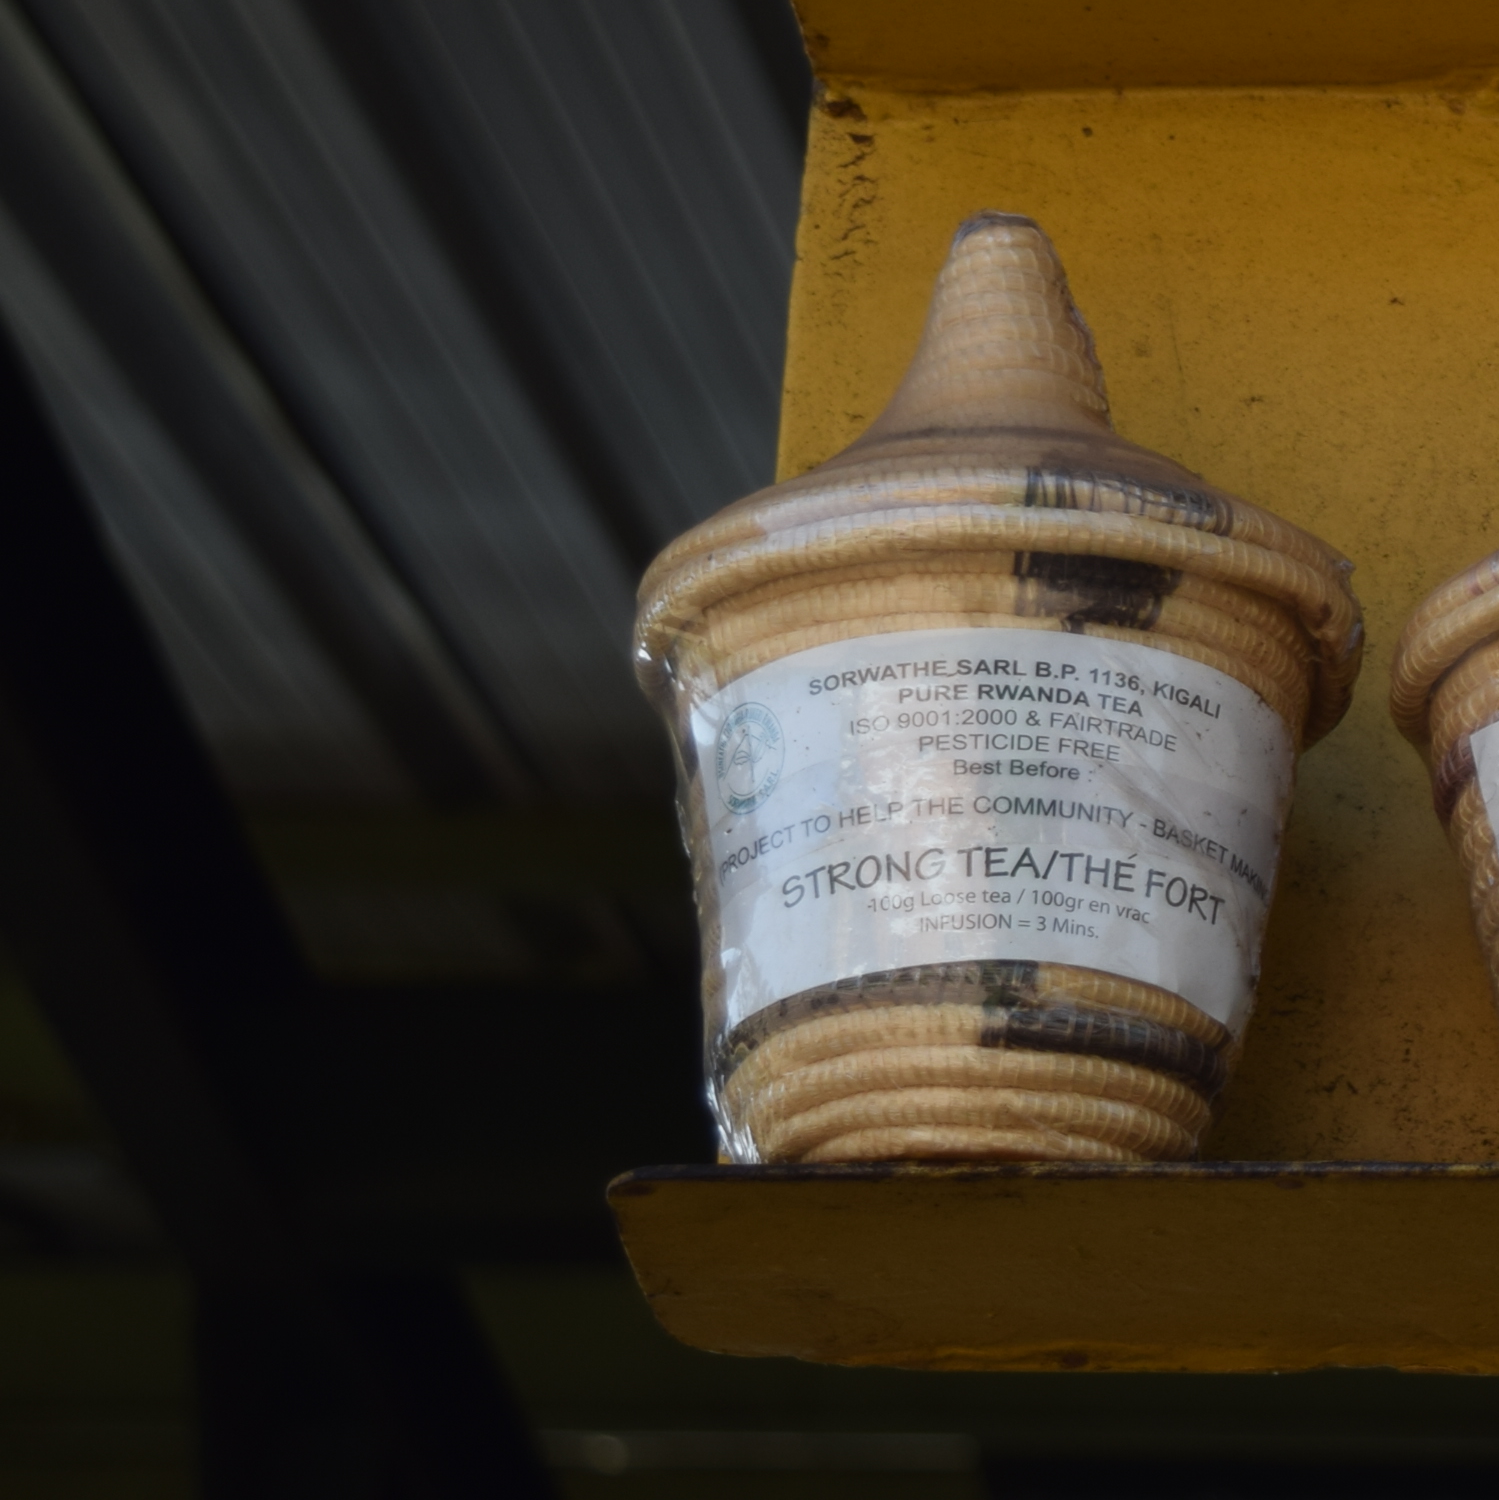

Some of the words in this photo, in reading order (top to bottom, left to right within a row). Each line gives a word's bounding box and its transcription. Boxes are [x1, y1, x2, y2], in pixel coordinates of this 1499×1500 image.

[808, 660, 947, 696] SORWATHE
[956, 659, 1027, 677] SARL
[1034, 661, 1079, 682] B.P.
[1089, 668, 1145, 696] 1136,
[1153, 680, 1222, 719] KIGALI
[899, 684, 969, 704] PURE
[977, 684, 1090, 708] RWANDA
[1099, 693, 1144, 718] TEA
[850, 715, 890, 736] ISO
[897, 708, 1018, 729] 9001:2000
[1026, 709, 1042, 727] &
[1049, 711, 1178, 752] FAIRTRADE
[918, 733, 1050, 753] PESTICIDE
[1058, 738, 1121, 763] FREE
[953, 759, 1003, 777] Best
[1010, 759, 1080, 780] Before
[801, 815, 831, 838] TO
[838, 800, 903, 829] HELP
[912, 797, 965, 816] THE
[973, 796, 1134, 828] COMMUNITY
[1153, 818, 1229, 865] BASKET
[782, 847, 946, 908] STRONG
[957, 846, 1138, 892] TEA/THÉ
[1145, 868, 1226, 926] FORT
[921, 889, 976, 906] Loose
[982, 889, 1012, 904] tea
[1032, 889, 1085, 913] 100gr
[1089, 899, 1111, 914] en
[1116, 904, 1151, 925] vrac
[920, 912, 1012, 932] INFUSION
[1036, 914, 1047, 932] 3
[1052, 917, 1099, 939] Mins.
